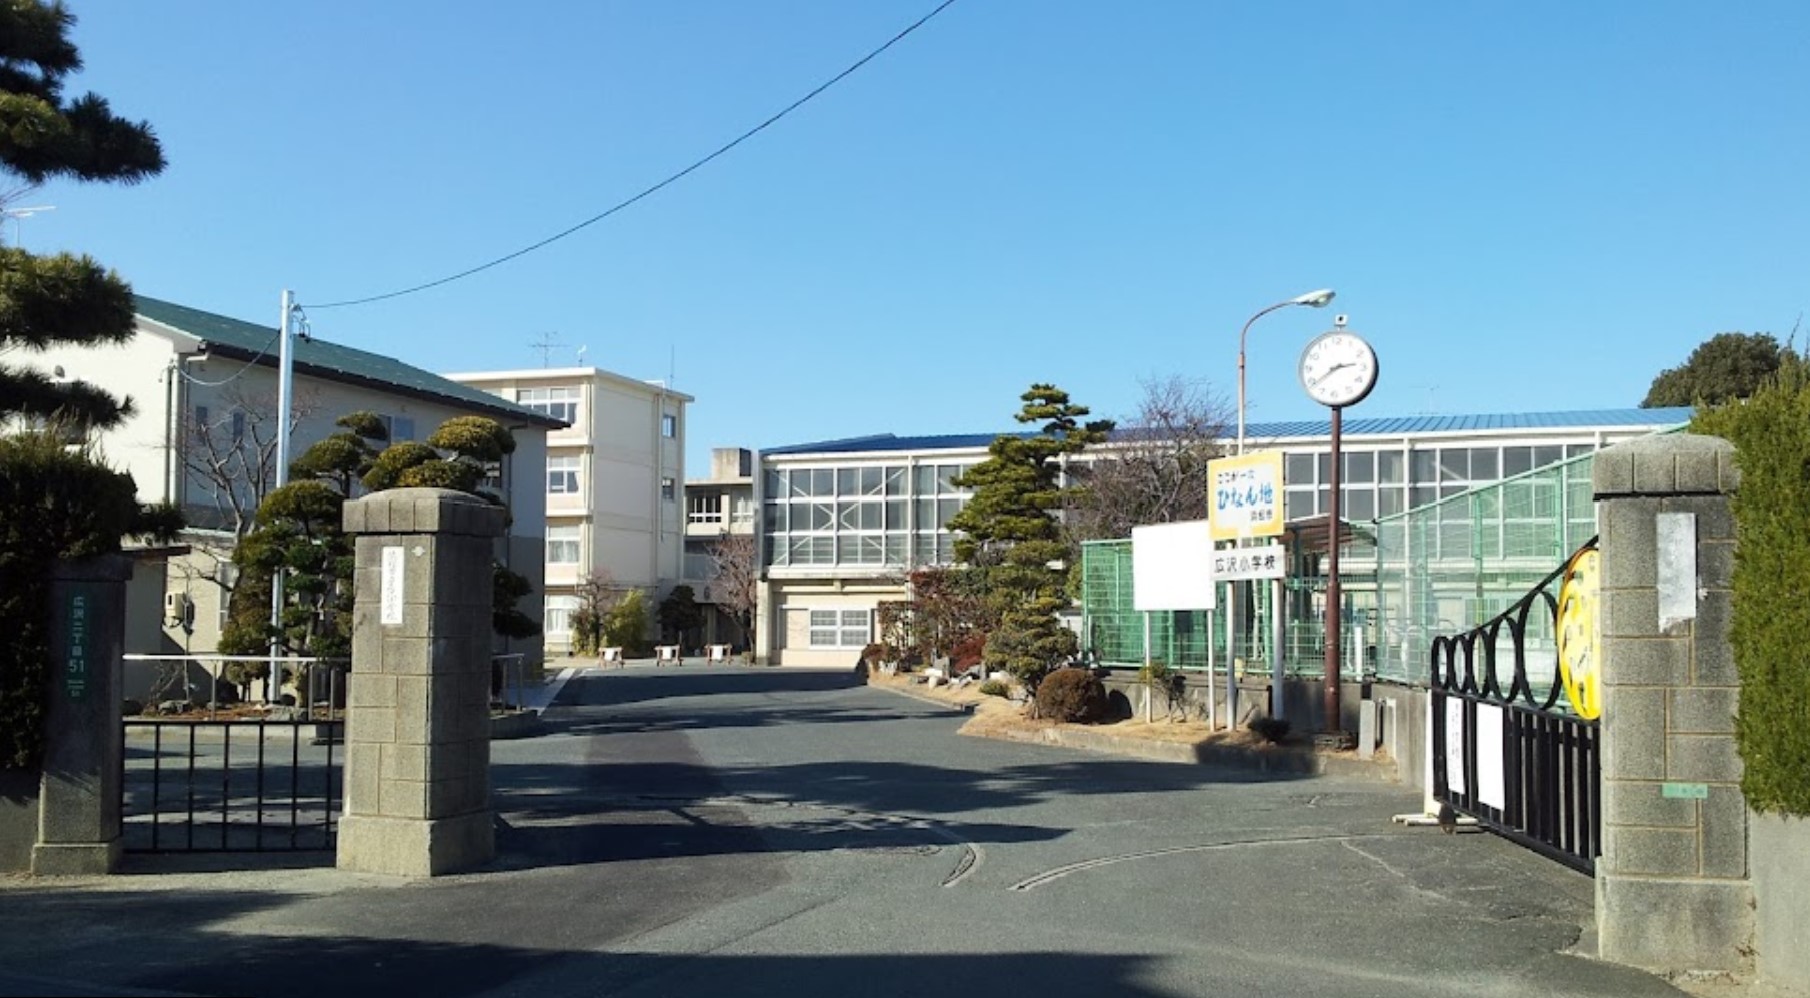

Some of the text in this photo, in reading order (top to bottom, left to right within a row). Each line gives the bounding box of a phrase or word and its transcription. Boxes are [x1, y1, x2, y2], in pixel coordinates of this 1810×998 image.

[1318, 341, 1327, 350] 11
[1331, 336, 1342, 345] 12
[1217, 482, 1273, 511] ひなん地
[1214, 555, 1276, 573] 広沢小学校
[69, 659, 85, 673] 51
